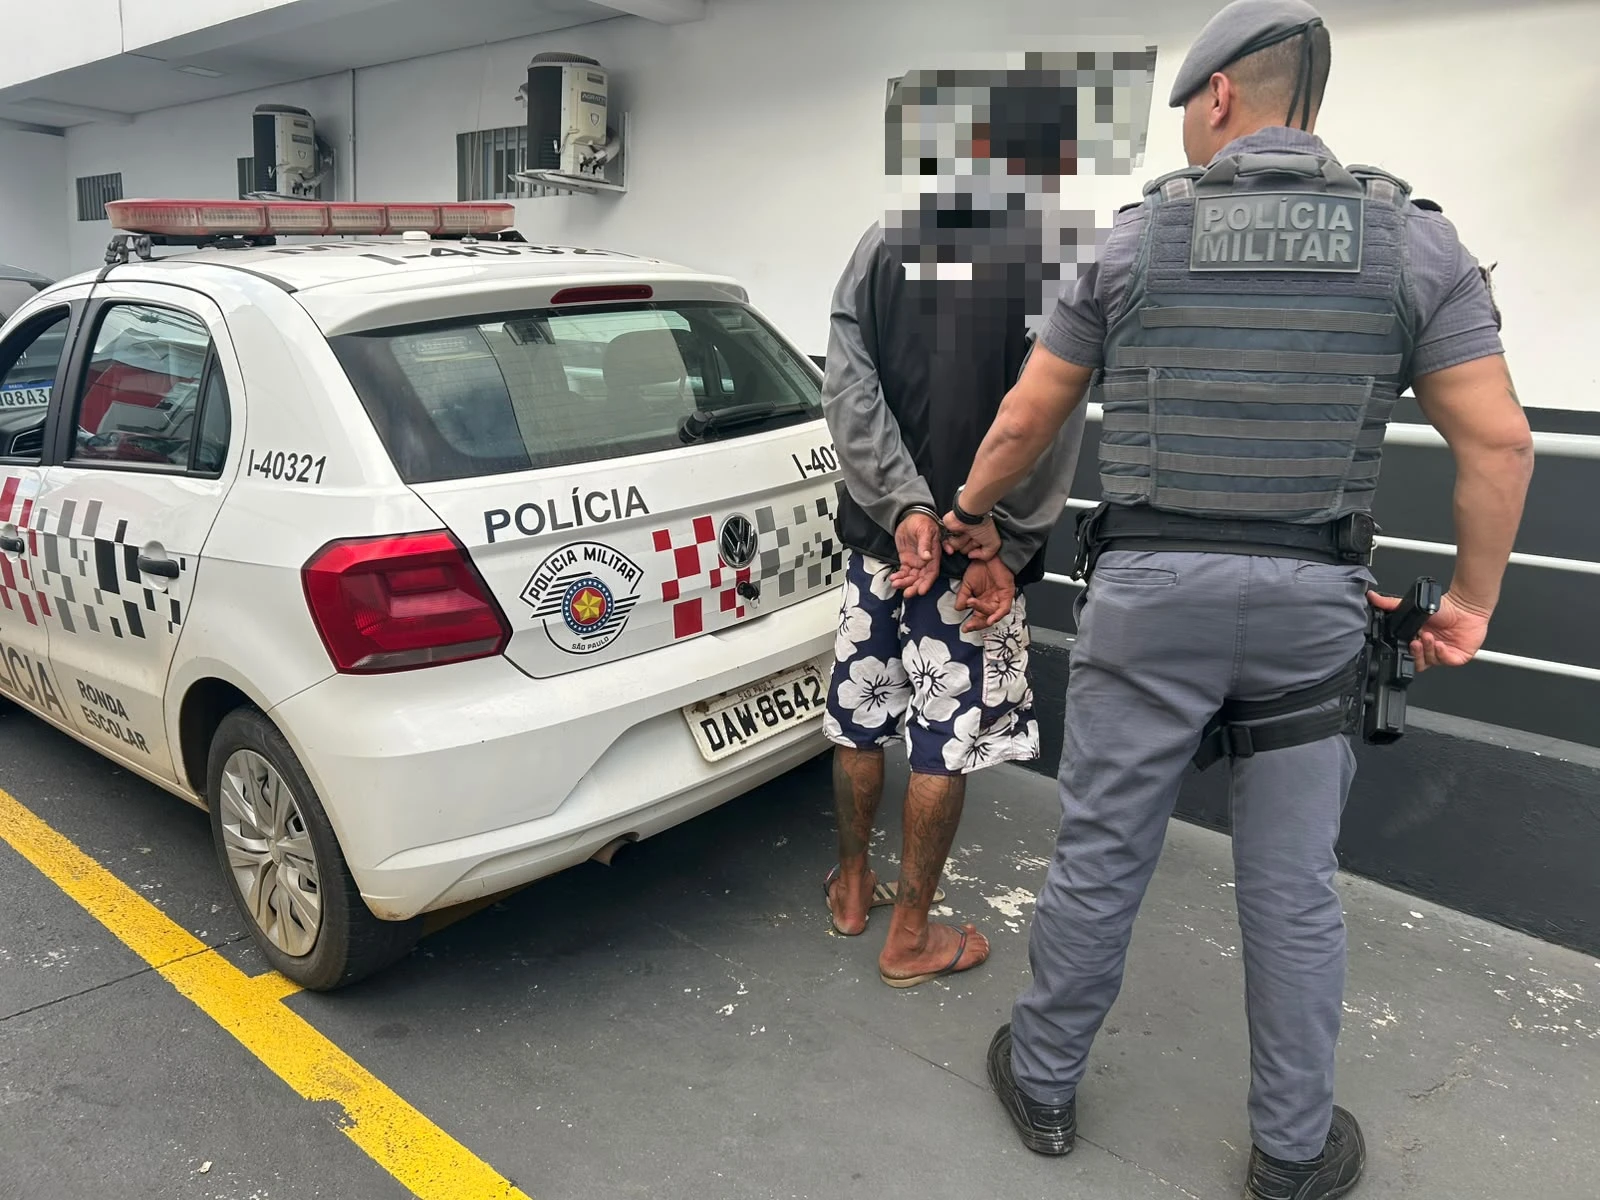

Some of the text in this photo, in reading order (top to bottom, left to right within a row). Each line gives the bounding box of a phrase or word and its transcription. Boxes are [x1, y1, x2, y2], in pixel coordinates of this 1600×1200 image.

[1202, 197, 1354, 231] POLÍCIA
[1200, 232, 1352, 262] MILITAR
[247, 449, 327, 484] I-40321
[791, 443, 837, 479] I-40
[484, 485, 650, 543] POLÍCIA
[528, 547, 636, 601] POLÍCIA MILITAR
[571, 636, 610, 650] SÃO PAULO
[76, 678, 130, 721] RONDA
[80, 704, 151, 754] ESCOLAR
